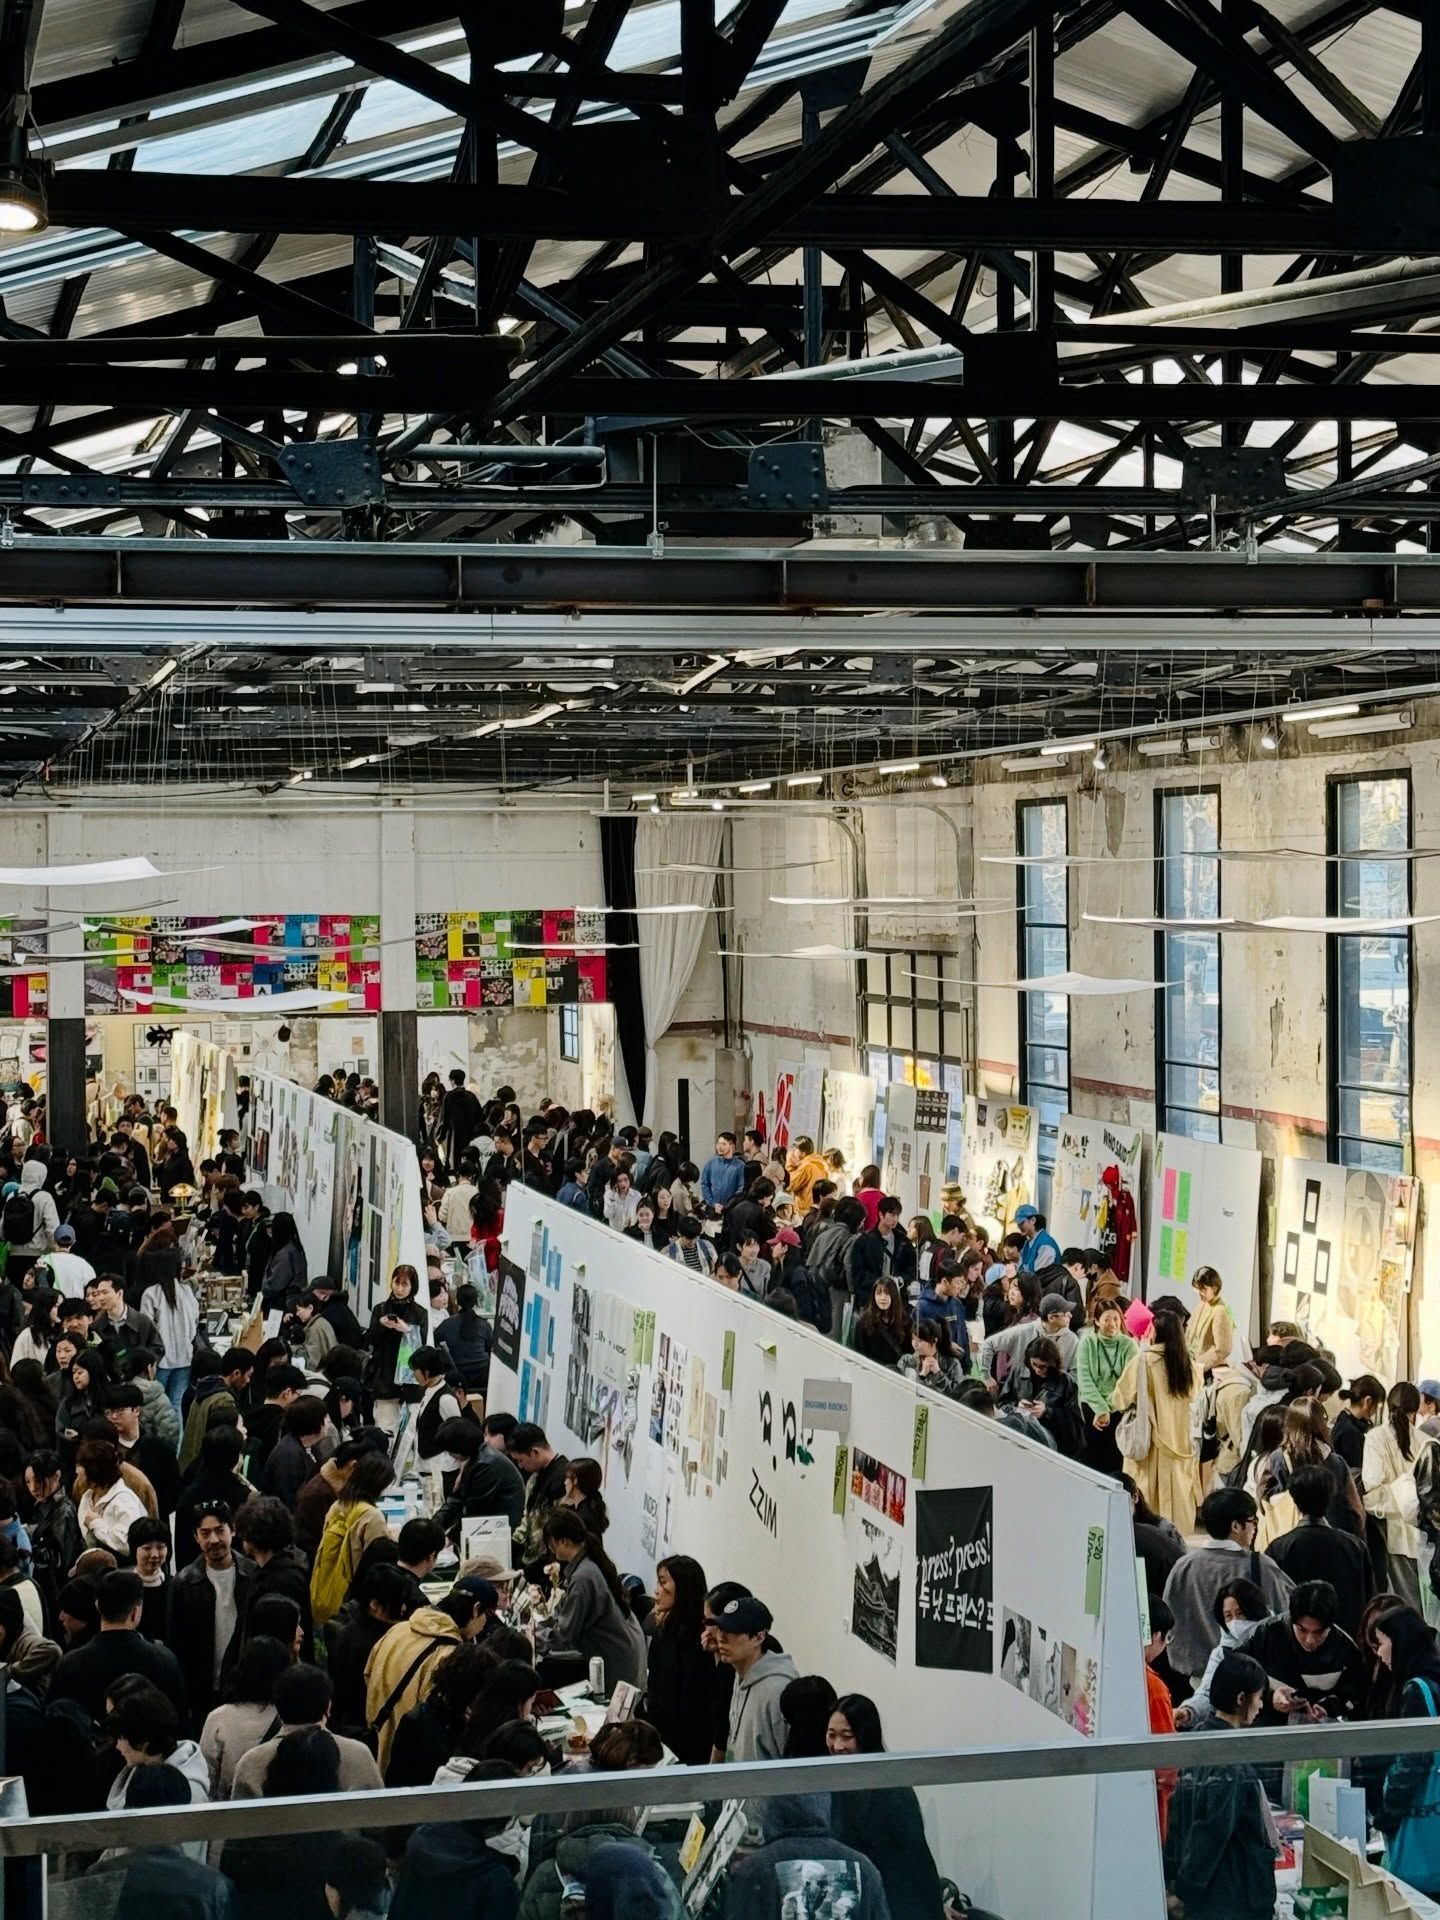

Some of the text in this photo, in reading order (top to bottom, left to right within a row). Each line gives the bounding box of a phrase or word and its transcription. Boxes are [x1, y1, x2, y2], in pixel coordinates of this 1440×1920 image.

[921, 1535, 955, 1586] press?
[954, 1521, 991, 1589] press!
[919, 1585, 930, 1619] 두
[932, 1587, 943, 1623] 낫
[943, 1592, 985, 1630] 프레스?
